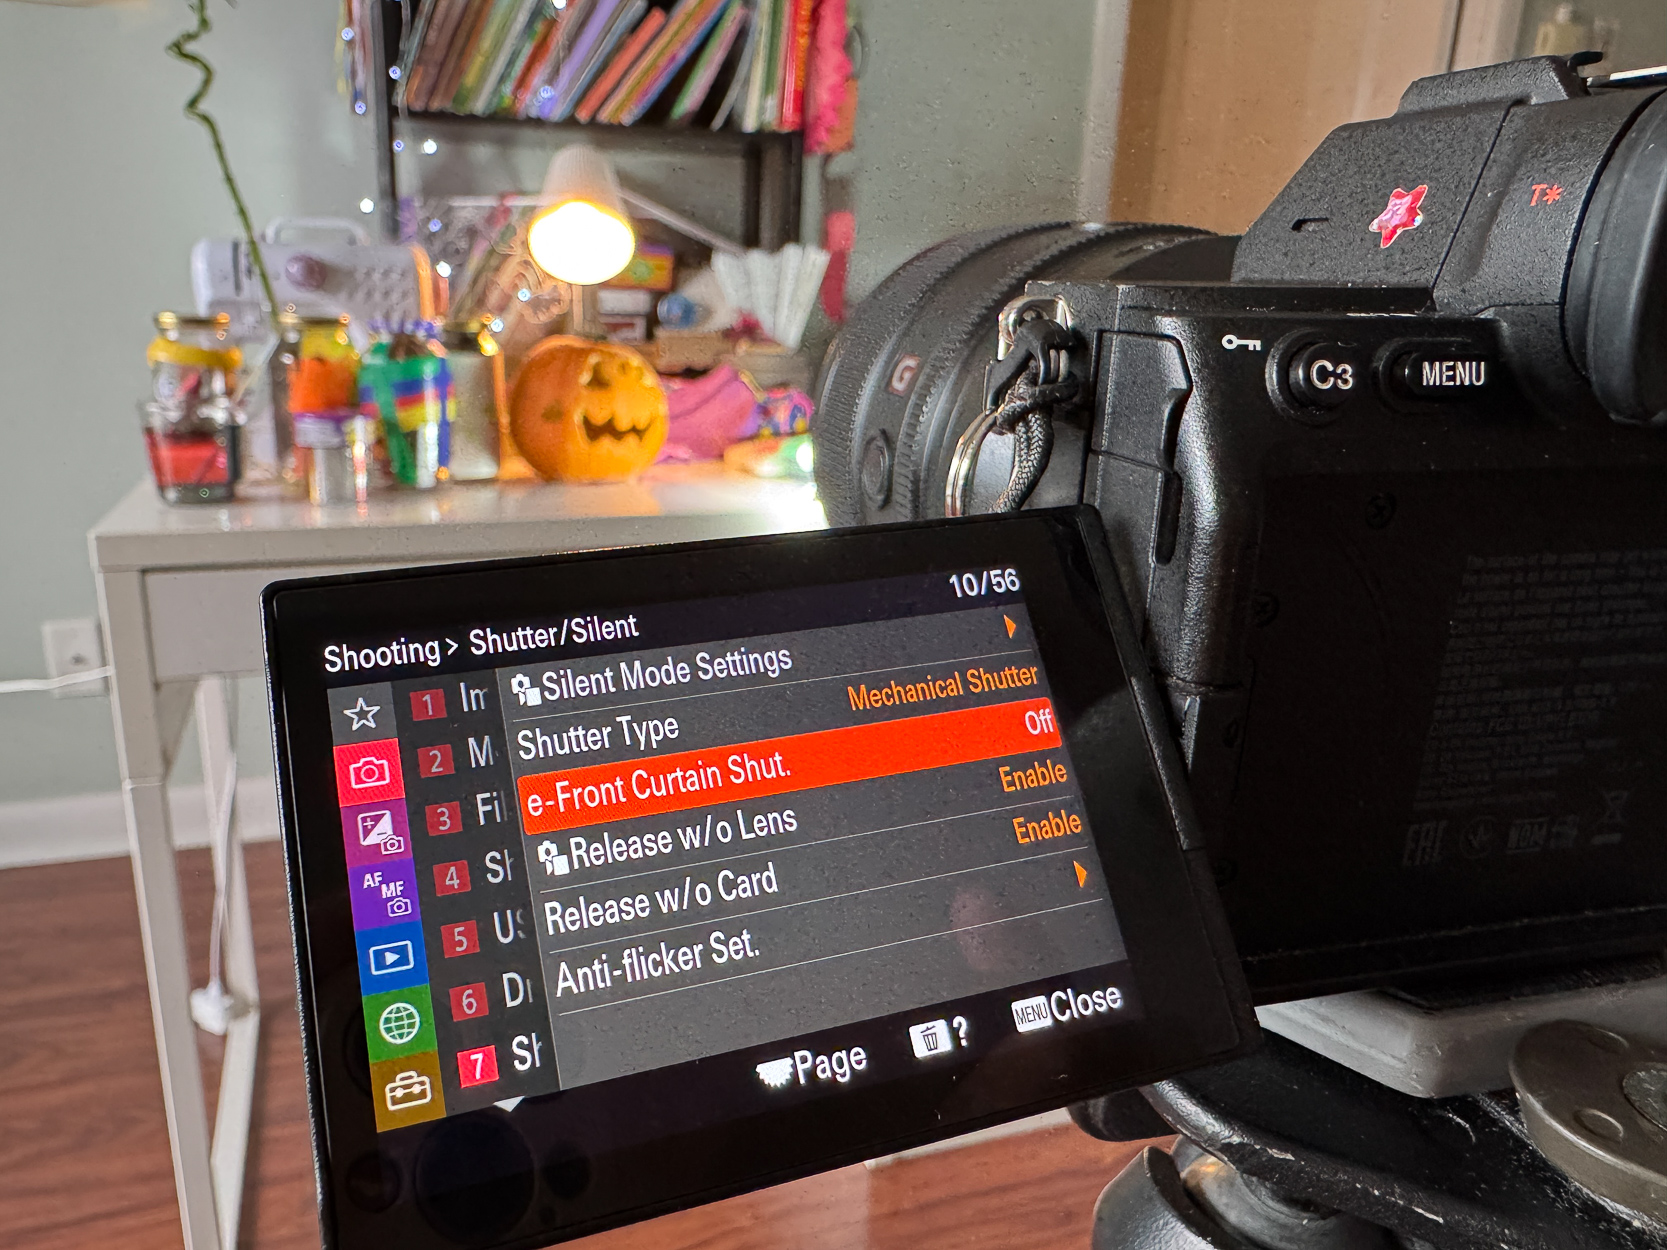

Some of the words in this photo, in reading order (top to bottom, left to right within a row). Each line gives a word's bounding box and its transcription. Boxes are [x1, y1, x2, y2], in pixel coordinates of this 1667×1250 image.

[892, 357, 919, 392] G
[1310, 360, 1353, 390] C3
[1422, 361, 1485, 386] MENU
[949, 568, 1020, 598] 10/56
[323, 637, 440, 673] Shooting
[469, 614, 639, 655] Shutter/Silent
[542, 667, 616, 701] Silent
[620, 656, 691, 690] Mode
[696, 647, 793, 680] Settings
[847, 671, 963, 711] Mechanical
[967, 664, 1038, 695] Shutter
[422, 694, 433, 716] 1
[1025, 708, 1054, 736] Off
[429, 750, 443, 773] 2
[468, 735, 499, 769] M
[517, 723, 612, 760] Shutter
[616, 715, 680, 750] Type
[527, 776, 626, 816] e-Front
[631, 760, 722, 799] Curtain
[727, 751, 791, 785] Shut.
[999, 759, 1068, 792] Enable
[436, 807, 450, 831] 3
[1013, 809, 1082, 844] Enable
[569, 831, 672, 870] Release
[677, 815, 732, 850] w/o
[736, 809, 798, 841] Lens
[363, 872, 383, 889] AF
[381, 881, 404, 898] MF
[445, 866, 460, 889] 4
[544, 893, 650, 935] Release
[655, 877, 712, 914] w/o
[717, 862, 778, 901] Card
[454, 927, 467, 952] 5
[556, 941, 703, 997] Anti-flicker
[709, 929, 760, 964] Set.
[462, 989, 477, 1014] 6
[1014, 1000, 1048, 1026] MENU
[1051, 985, 1122, 1023] Close
[470, 1053, 483, 1080] 7
[794, 1045, 868, 1085] Page
